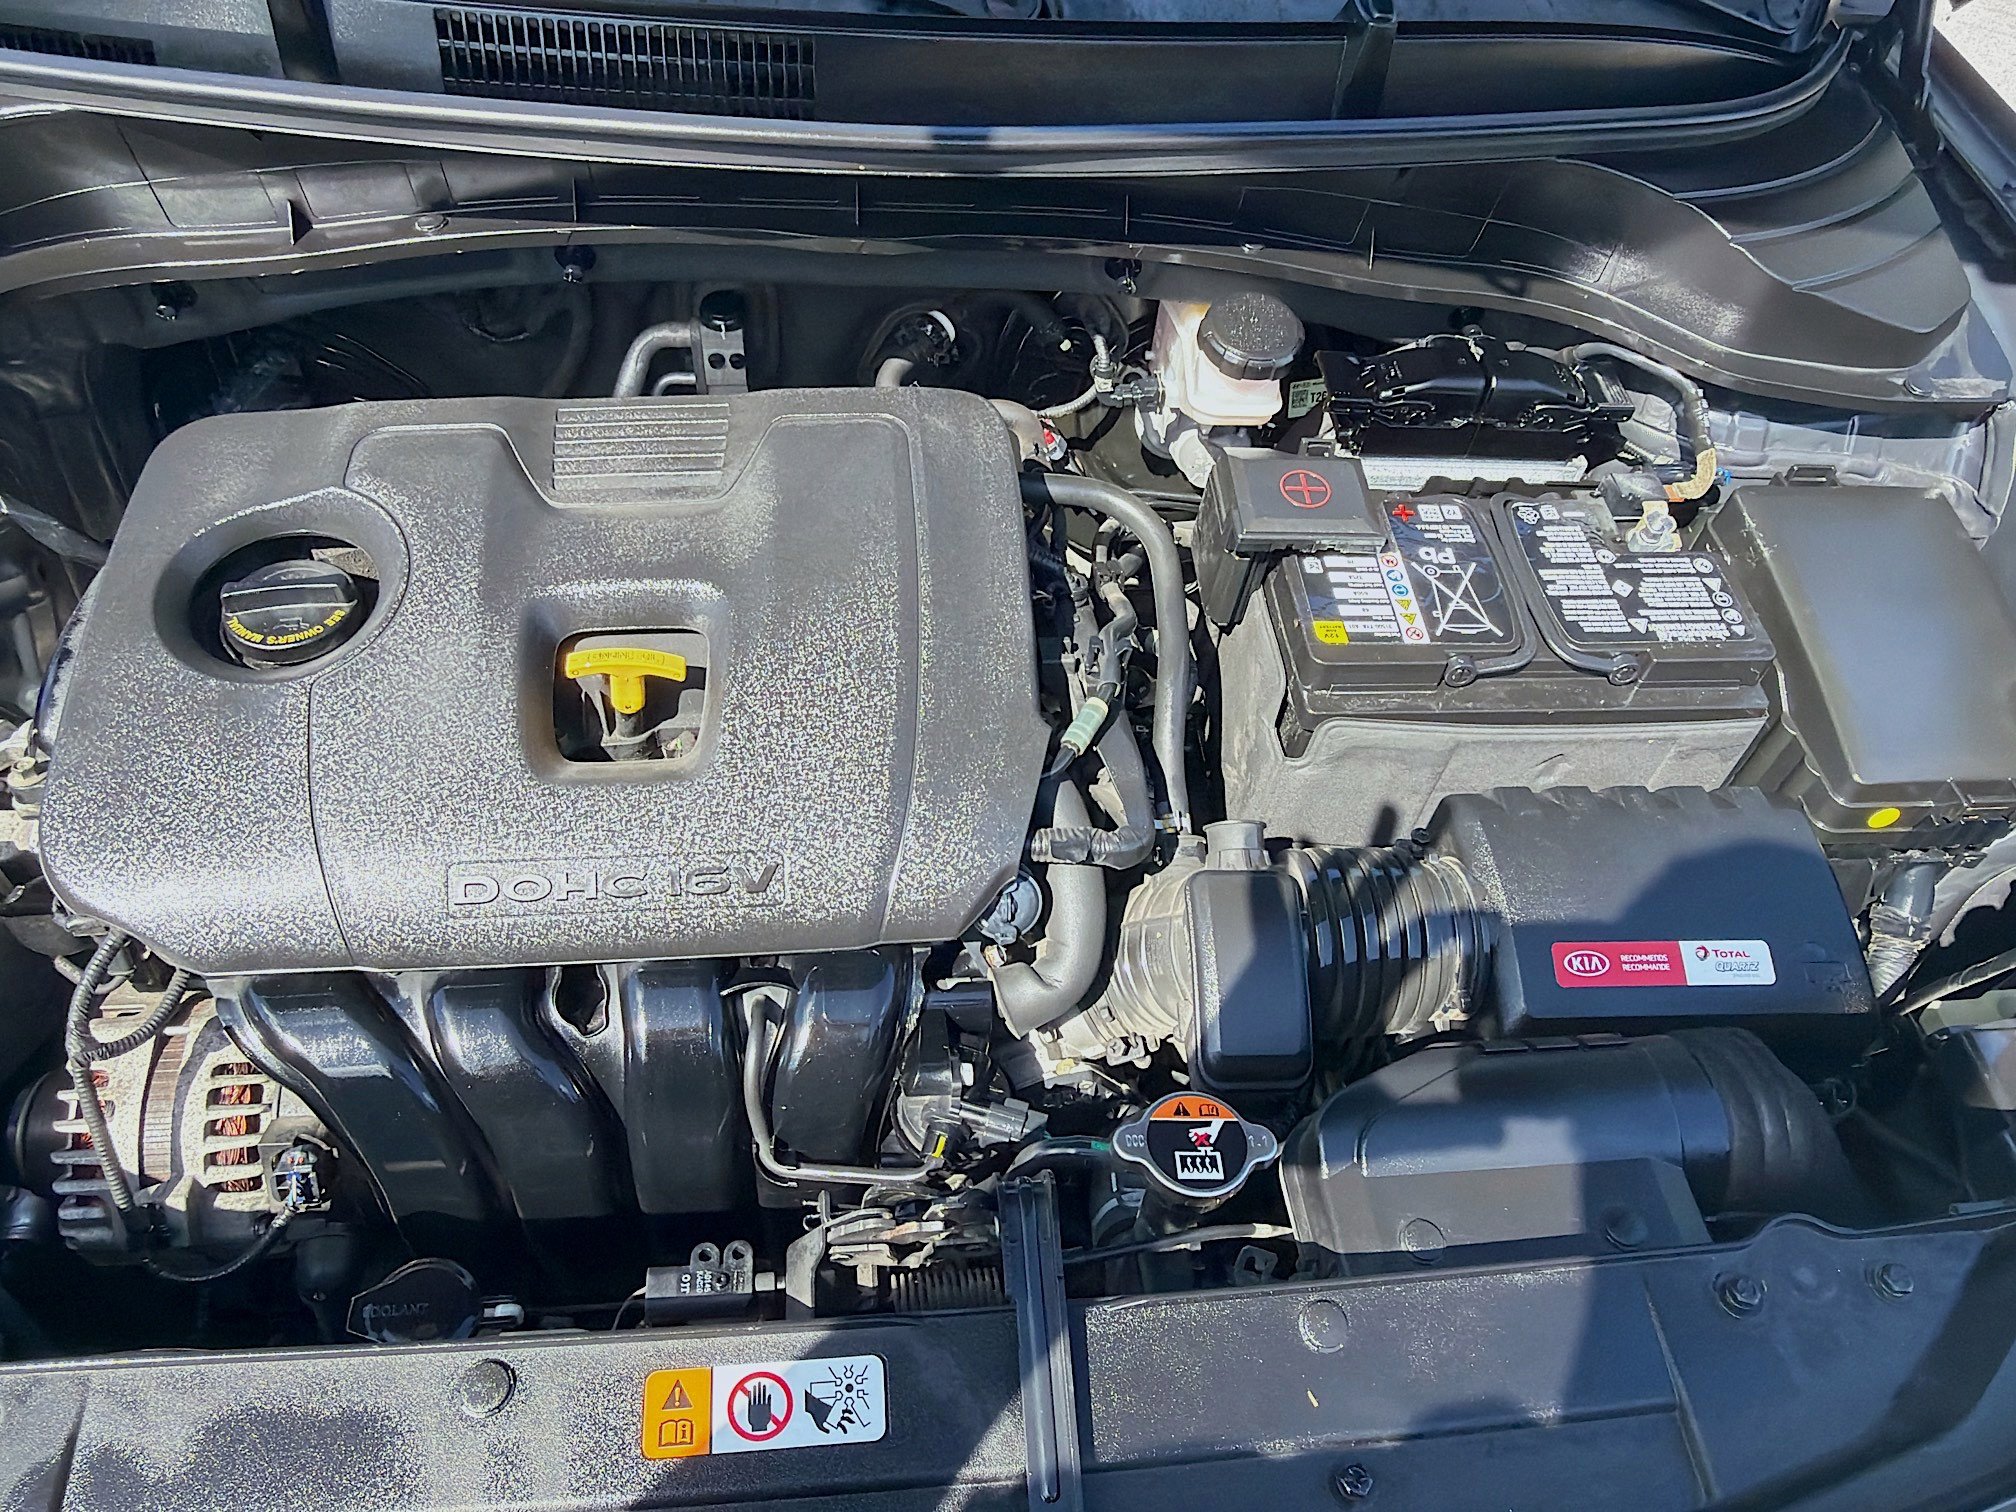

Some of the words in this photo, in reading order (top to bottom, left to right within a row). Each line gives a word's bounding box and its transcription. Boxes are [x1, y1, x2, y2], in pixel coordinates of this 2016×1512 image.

[1418, 546, 1457, 565] Pb
[226, 616, 265, 643] MANUAL
[266, 625, 325, 645] OWNER'S
[453, 872, 648, 906] DOHC
[668, 863, 780, 898] 16V
[1571, 955, 1603, 971] KIA
[1715, 961, 1760, 973] QUARTZ
